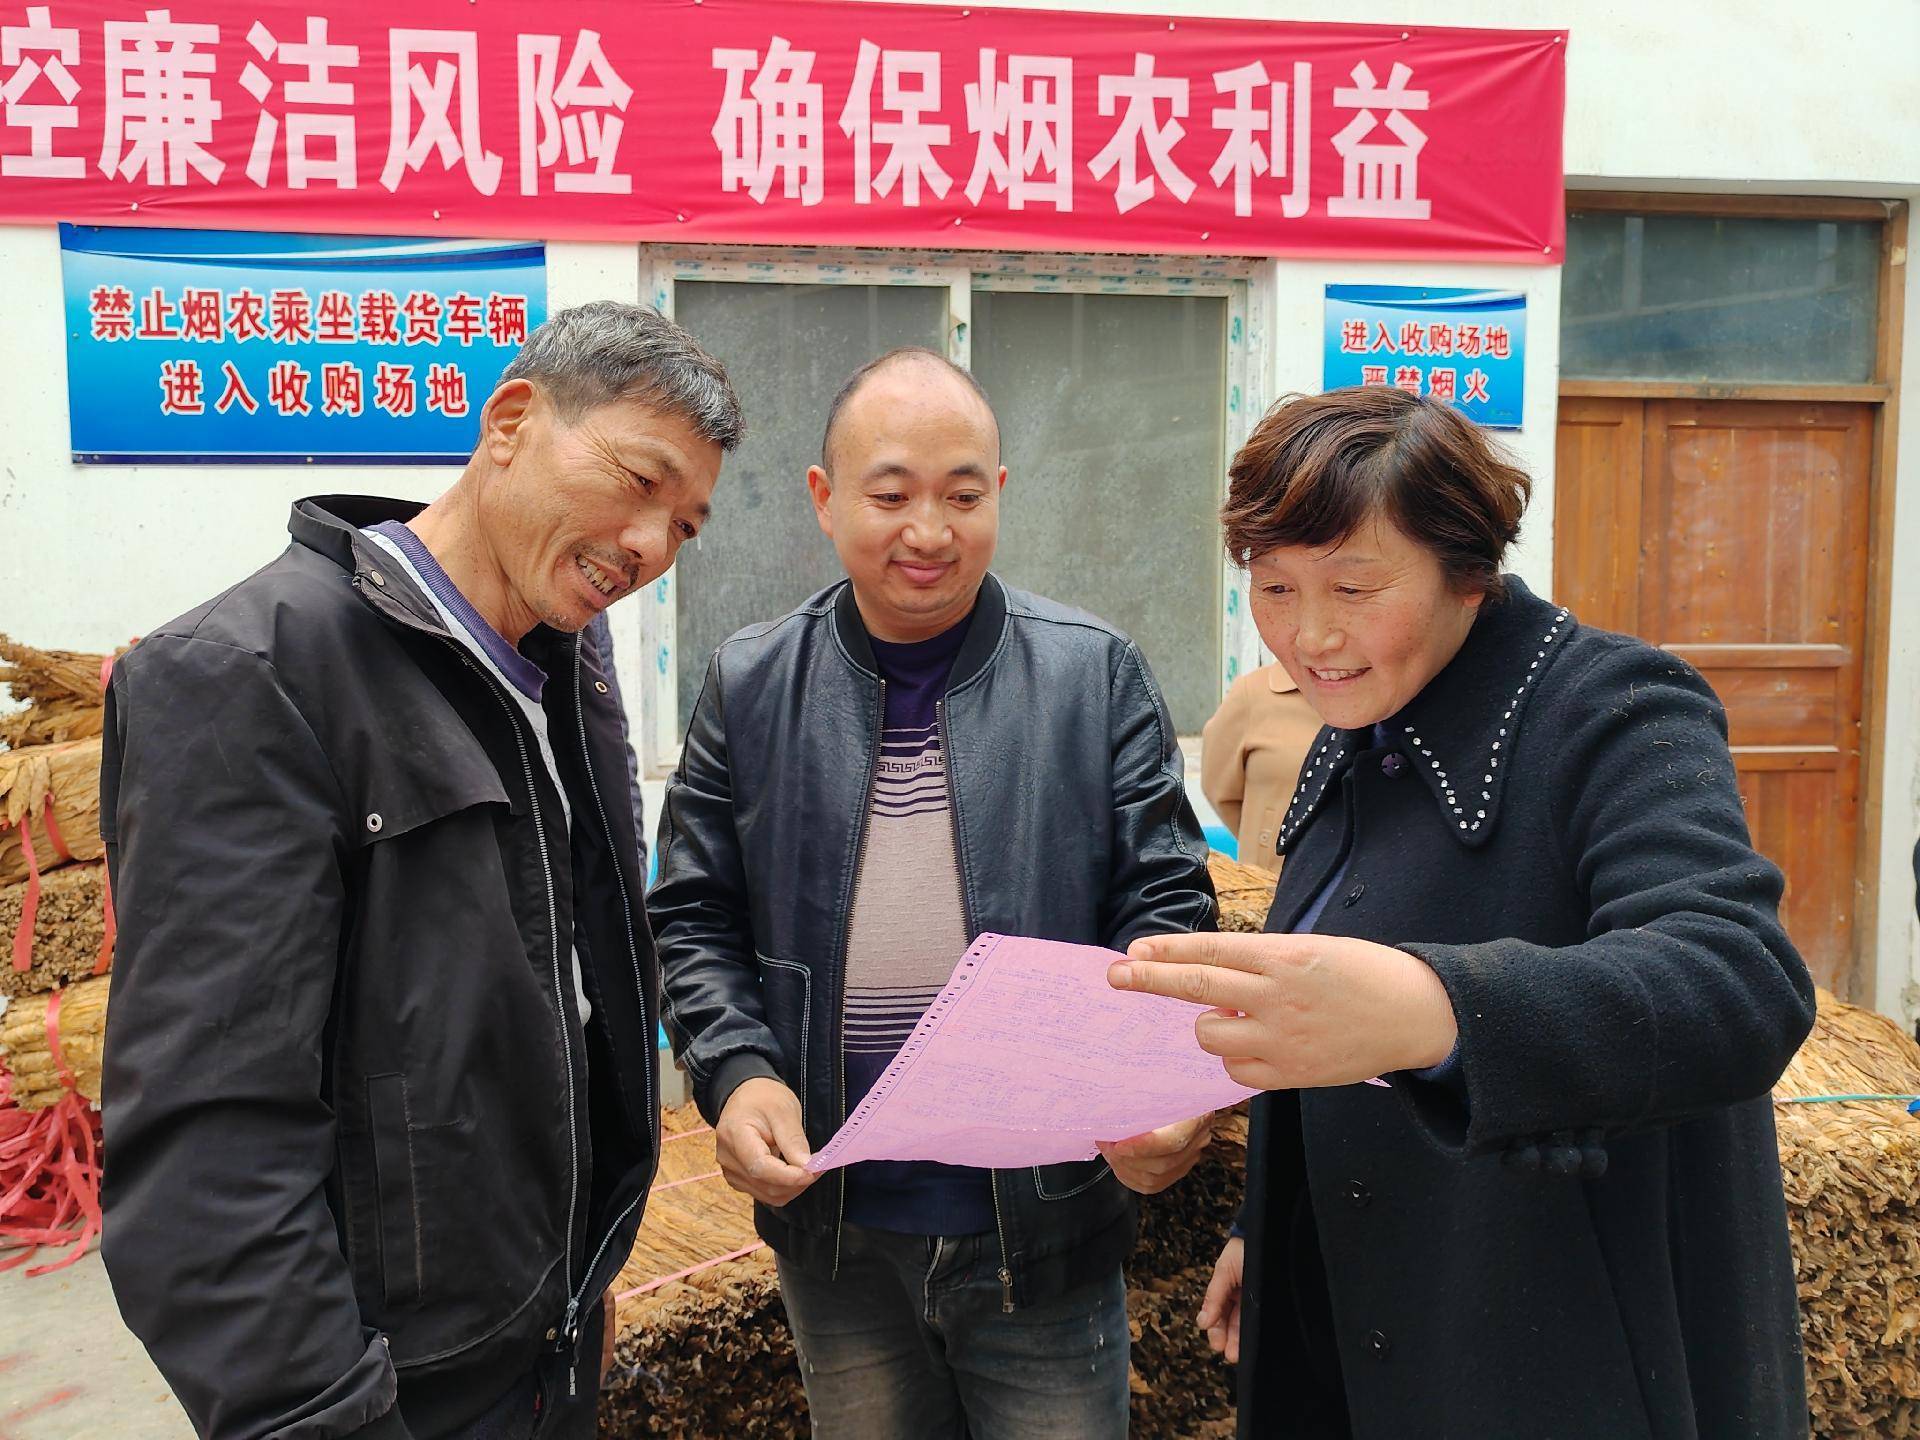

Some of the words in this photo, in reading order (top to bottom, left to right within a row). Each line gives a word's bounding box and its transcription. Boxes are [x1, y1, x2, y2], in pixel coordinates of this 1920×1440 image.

[712, 37, 1432, 221] 确保烟农利益
[89, 285, 528, 346] 禁止烟农乘坐载货车辆
[1341, 319, 1511, 358] 进入收购场地
[159, 360, 469, 416] 进入收购场地
